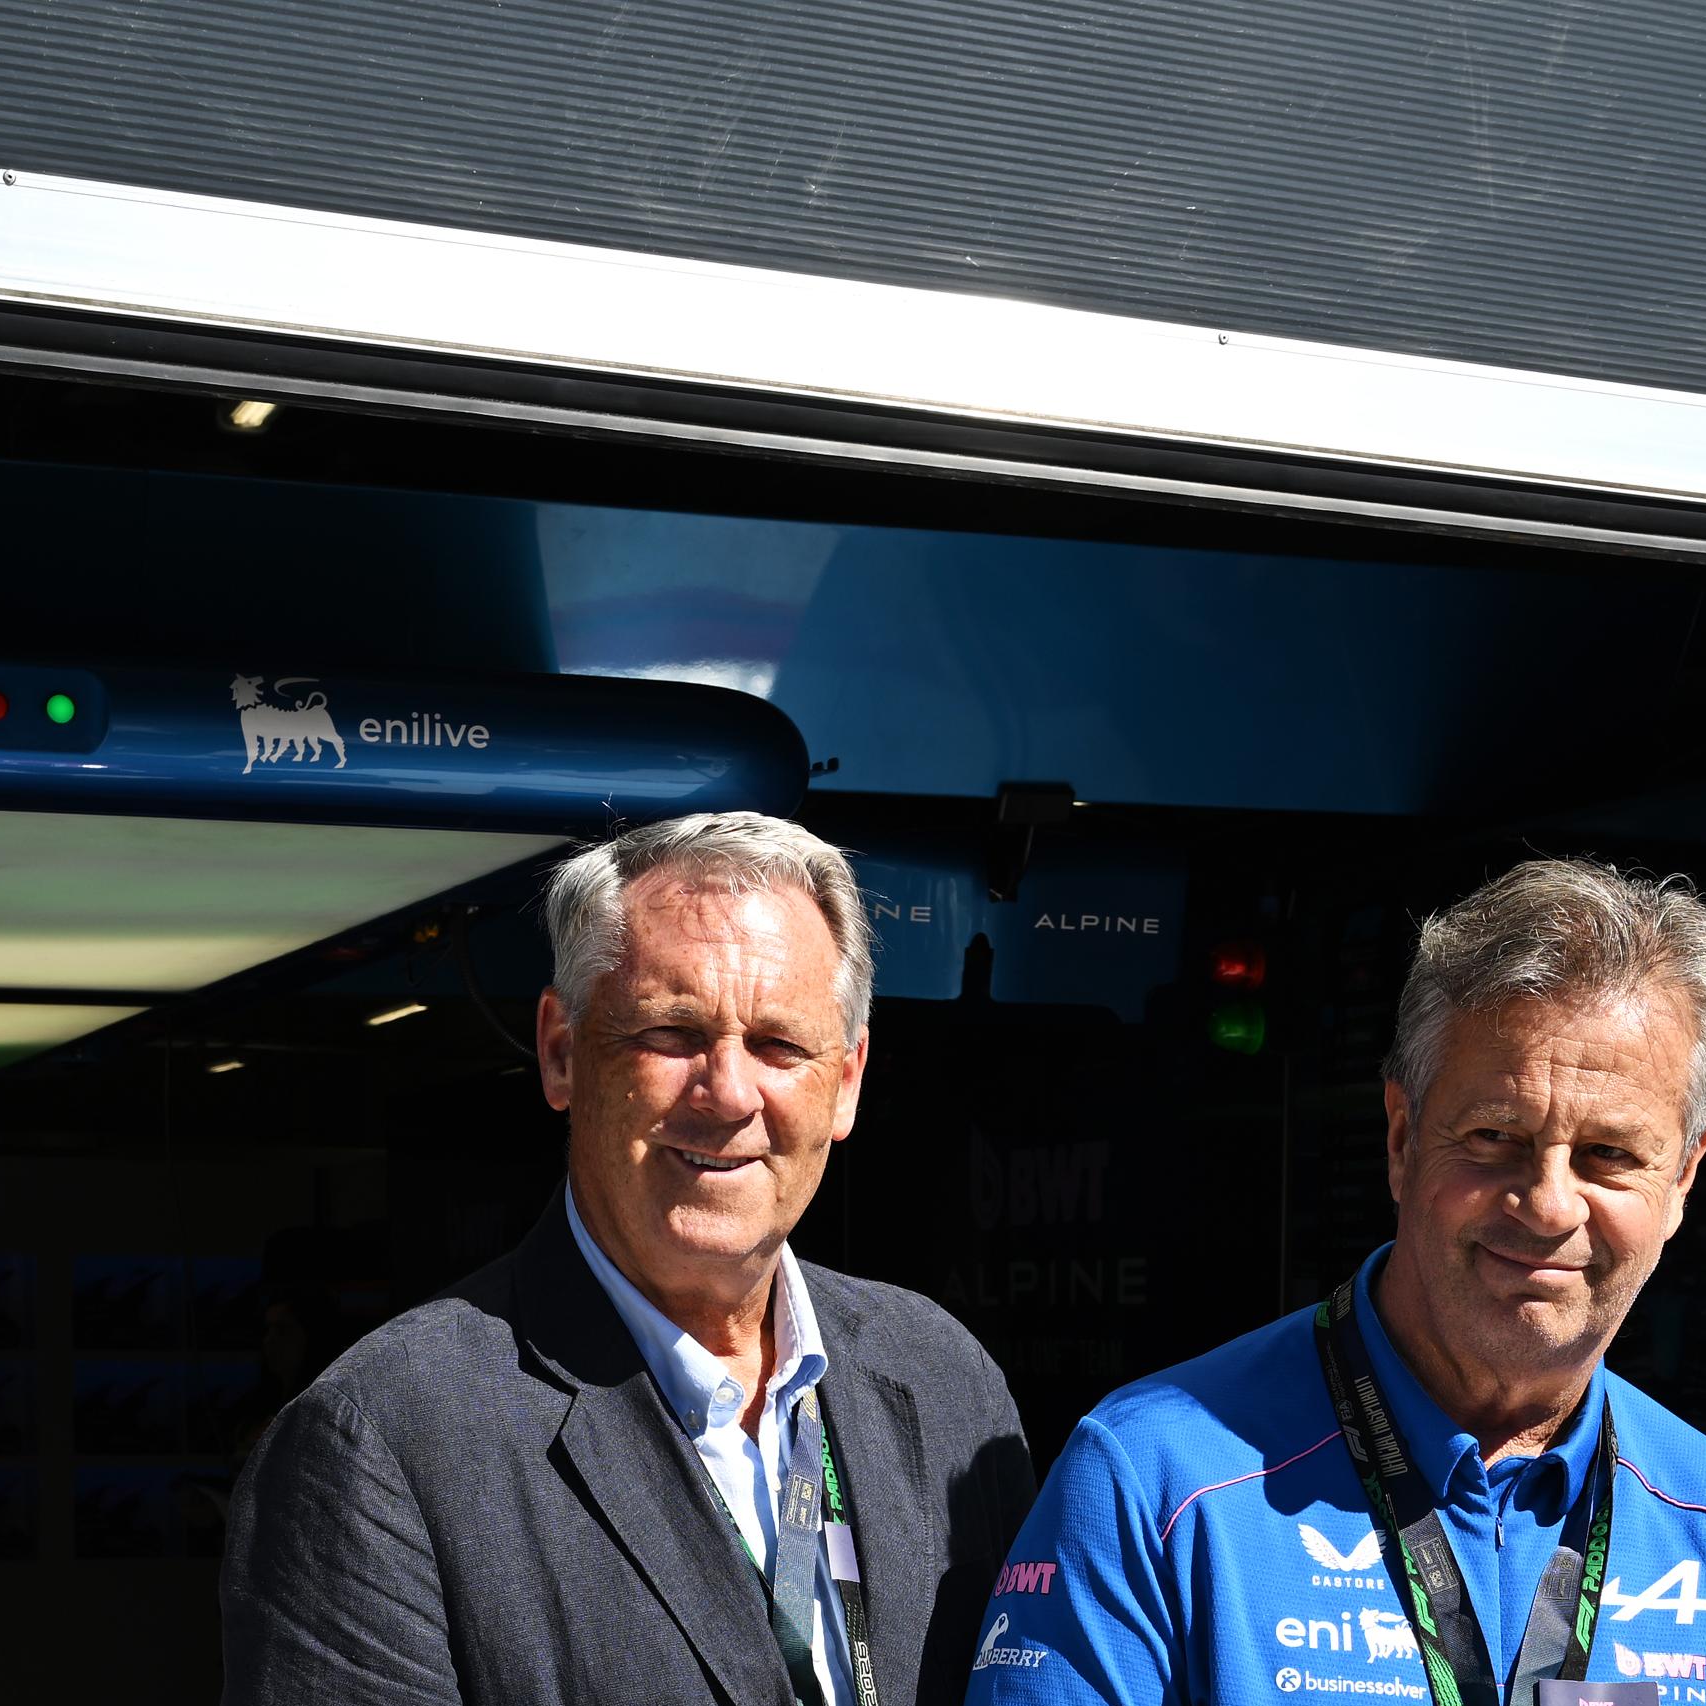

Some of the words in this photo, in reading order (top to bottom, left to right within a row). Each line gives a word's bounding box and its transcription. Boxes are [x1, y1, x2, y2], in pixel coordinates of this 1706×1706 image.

[358, 711, 490, 751] enilive
[1033, 913, 1160, 935] ALPINE
[1006, 1562, 1057, 1595] BWT
[1311, 1574, 1385, 1590] CASTORE
[1276, 1611, 1352, 1651] eni
[1305, 1675, 1427, 1700] businessolver
